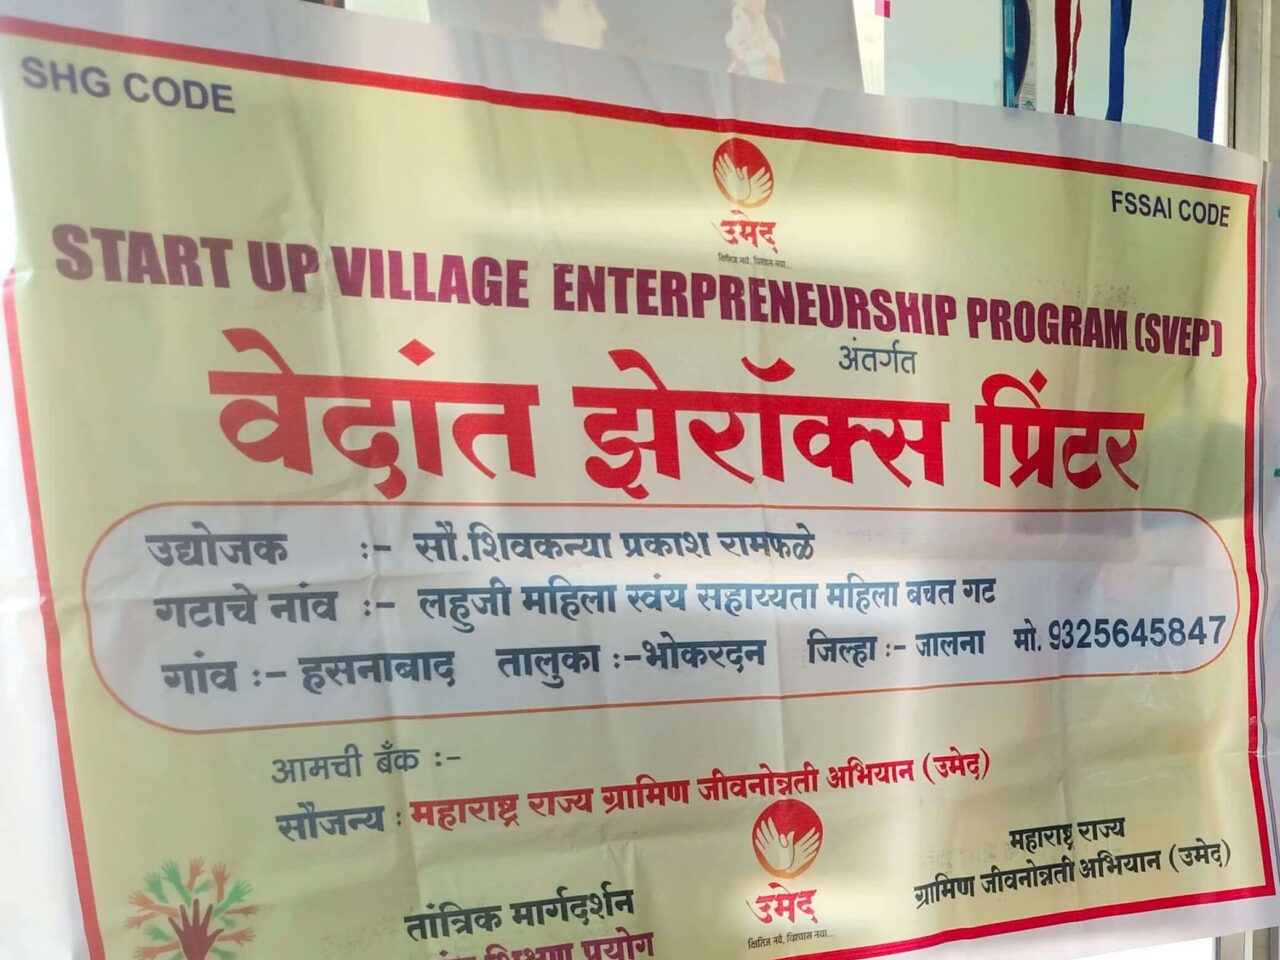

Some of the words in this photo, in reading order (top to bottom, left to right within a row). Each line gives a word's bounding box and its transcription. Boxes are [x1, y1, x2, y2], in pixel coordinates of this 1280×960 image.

[20, 55, 111, 99] SHG
[124, 72, 236, 114] CODE
[711, 209, 779, 254] उमेद
[1111, 190, 1172, 221] FSSAI
[1179, 198, 1231, 228] CODE
[51, 223, 233, 290] START
[248, 240, 320, 294] UP
[330, 245, 529, 308] VILLAGE
[553, 262, 957, 337] ENTERPRENEURSHIP
[967, 296, 1128, 351] PROGRAM
[1135, 311, 1223, 359] (SVEP)
[838, 338, 917, 376] अंतर्गत
[208, 328, 540, 499] वेदांत
[572, 349, 949, 498] झेरॉक्स
[974, 369, 1145, 491] प्रिंटर
[145, 521, 288, 566] उद्योजक
[619, 530, 711, 558] प्रकाश
[716, 522, 815, 560] रामफळे
[153, 583, 257, 628] गटाचे
[268, 581, 338, 623] नांव
[417, 576, 511, 633] लहुजी
[520, 575, 617, 621] महिला
[826, 572, 899, 614] महिला
[906, 578, 956, 606] बचत
[962, 577, 996, 604] गट
[161, 650, 237, 694] गांव
[298, 651, 455, 695] हसनाबाद
[496, 645, 600, 689] तालुका
[807, 629, 877, 667] जिल्हा
[916, 630, 985, 656] जालना
[1014, 618, 1042, 652] मो.
[1049, 615, 1227, 651] 9325645847
[272, 743, 362, 784] आमची
[374, 740, 420, 774] बँक
[276, 801, 385, 842] सौजन्य
[409, 794, 519, 831] महाराष्ट्र
[527, 788, 593, 817] राज्य
[601, 773, 690, 815] ग्रामिण
[697, 762, 819, 801] जीवनोन्नती
[826, 756, 914, 793] अभियान
[922, 745, 990, 785] (उमेद)
[1077, 817, 1125, 842] राज्य
[746, 882, 818, 924] उमेद
[913, 872, 975, 909] ग्रामिण
[981, 855, 1075, 894] जीवनोन्नती
[1079, 850, 1161, 879] अभियान
[403, 901, 502, 941] तांत्रिक
[509, 880, 634, 925] मार्गदर्शन
